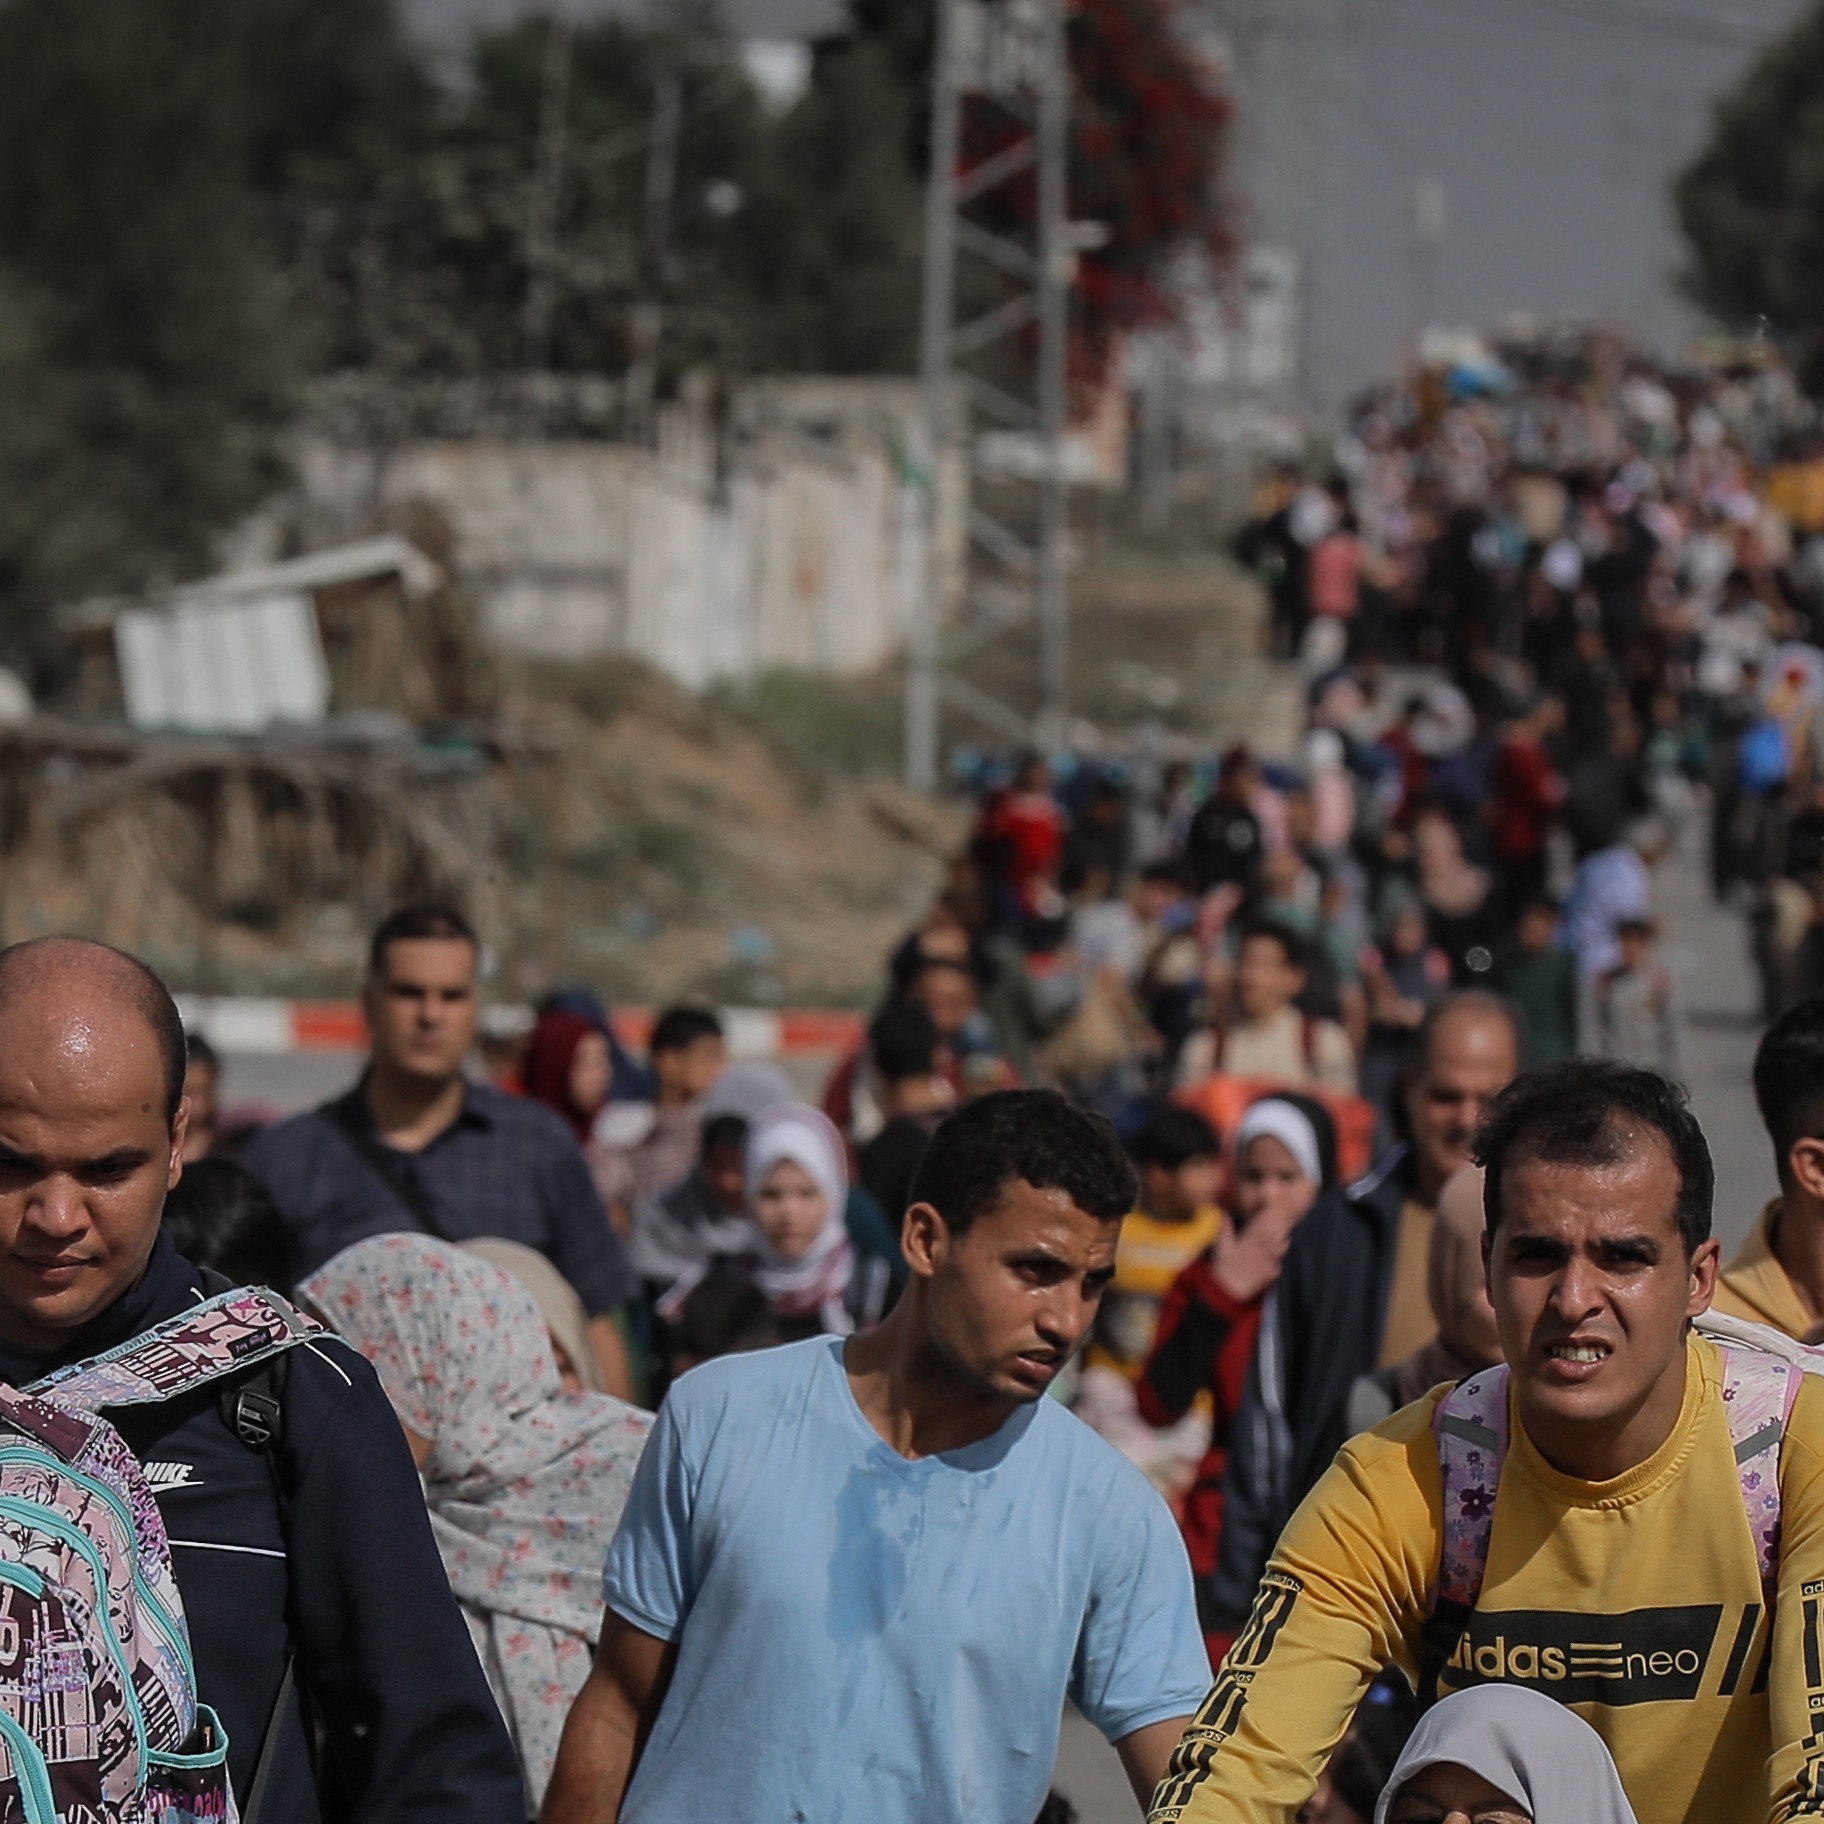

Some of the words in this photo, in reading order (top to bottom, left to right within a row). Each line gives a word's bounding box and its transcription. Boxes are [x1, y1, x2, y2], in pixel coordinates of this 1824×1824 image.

[142, 1461, 194, 1482] NIKE
[1447, 1632, 1567, 1680] idas
[1626, 1649, 1699, 1679] neo
